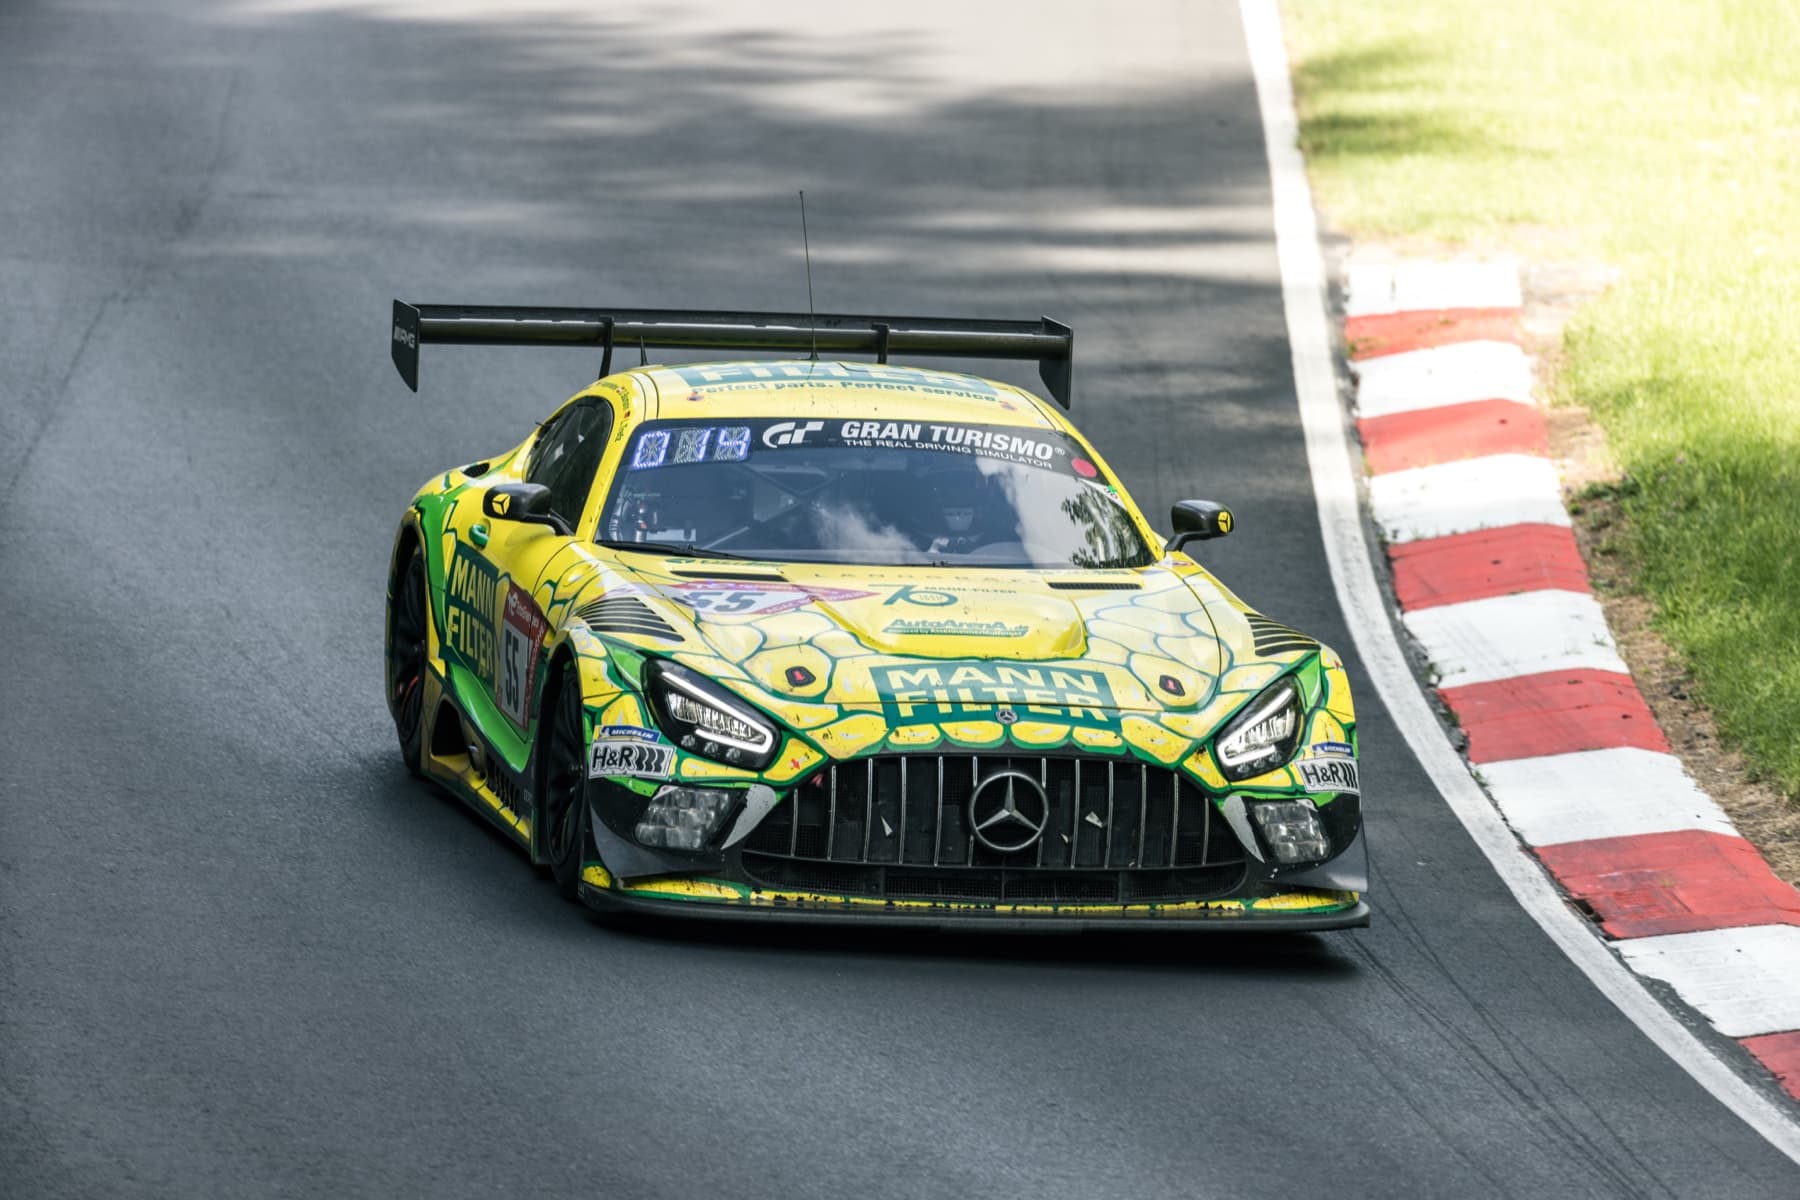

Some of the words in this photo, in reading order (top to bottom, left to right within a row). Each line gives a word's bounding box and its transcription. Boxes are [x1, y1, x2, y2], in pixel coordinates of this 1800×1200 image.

[692, 383, 768, 393] Perfect
[775, 381, 833, 390] parts.
[840, 381, 917, 392] Perfect
[841, 420, 920, 441] GRAN
[844, 439, 873, 447] THE
[876, 440, 913, 449] REAL
[915, 441, 971, 454] DRIVING
[975, 447, 1053, 469] SIMULATOR
[451, 554, 495, 624] MANN
[672, 591, 767, 612] 55
[446, 605, 494, 678] FILTER
[505, 628, 519, 714] 55
[886, 666, 1098, 693] MANN
[894, 687, 1110, 722] FILTER
[611, 729, 654, 739] MICHELIN
[592, 747, 635, 769] H&R
[1301, 762, 1342, 783] H&R
